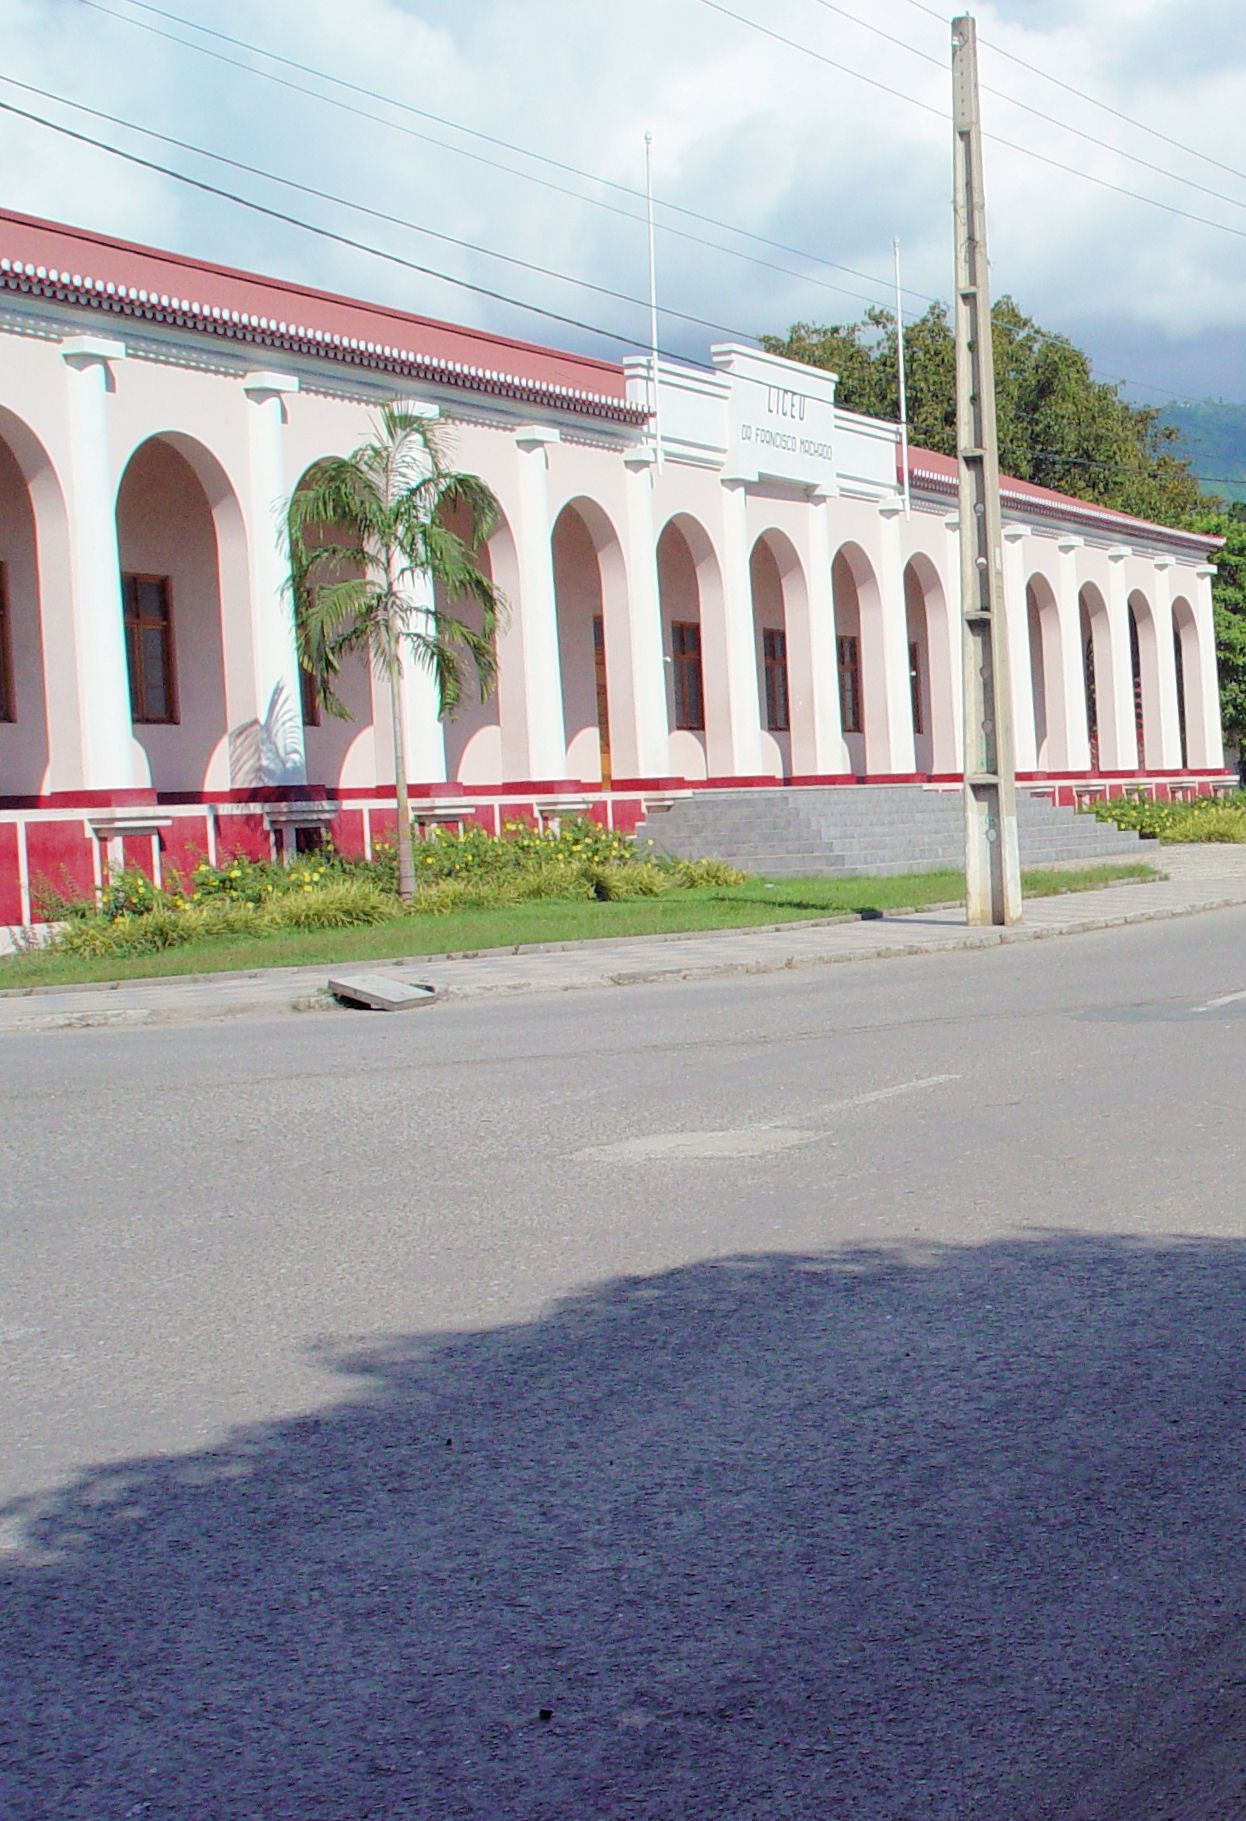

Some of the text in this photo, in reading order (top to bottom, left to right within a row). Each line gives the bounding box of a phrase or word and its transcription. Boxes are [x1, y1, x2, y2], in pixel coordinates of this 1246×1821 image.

[767, 386, 805, 420] LICEU
[755, 427, 797, 452] FRANCISCO
[799, 438, 833, 461] MACHADO
